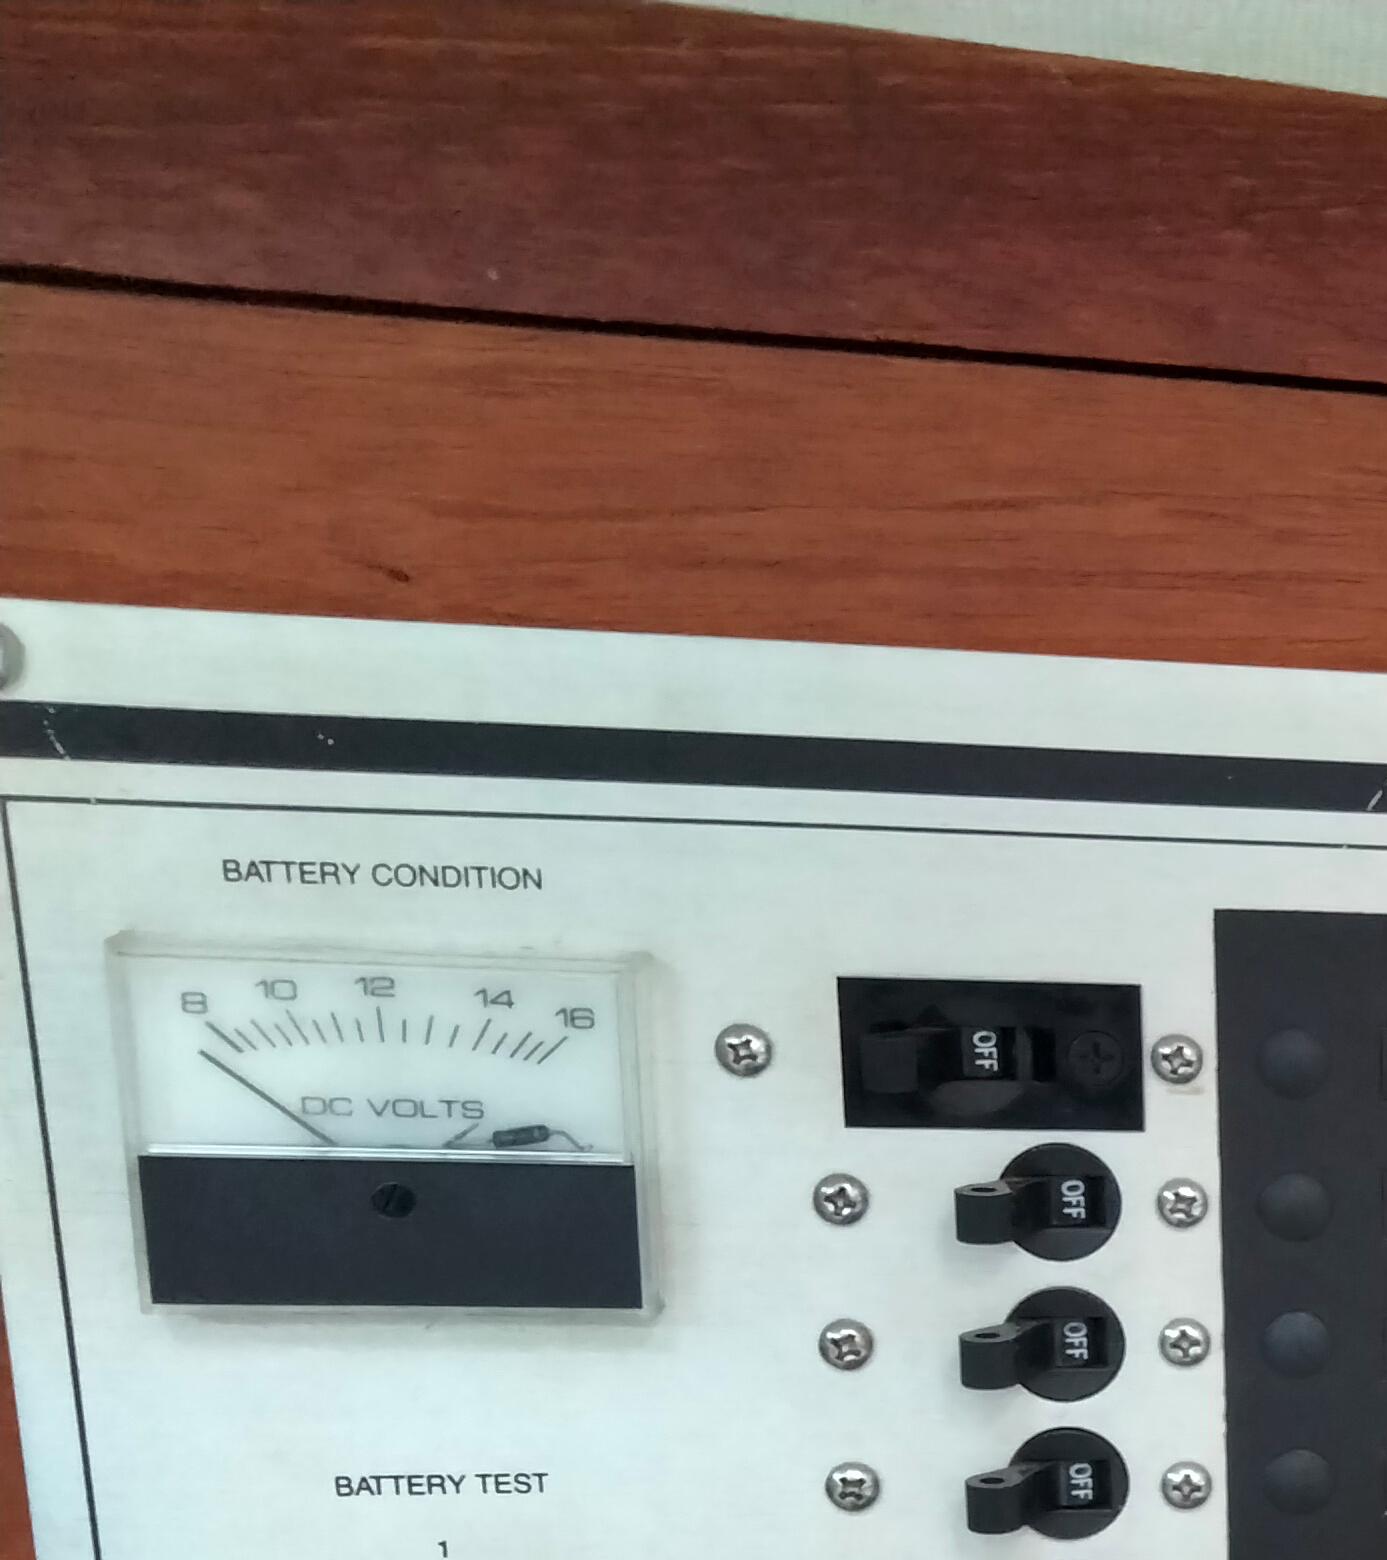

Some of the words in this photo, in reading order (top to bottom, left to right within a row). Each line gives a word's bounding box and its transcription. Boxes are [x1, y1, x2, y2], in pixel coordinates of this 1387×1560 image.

[222, 858, 361, 887] BATTERY
[371, 862, 544, 891] CONDITION
[255, 978, 298, 1001] 10
[354, 976, 396, 998] 12
[473, 987, 515, 1010] 14
[180, 991, 209, 1014] 8
[555, 1006, 596, 1030] 16
[972, 1029, 999, 1073] OFF
[301, 1096, 353, 1117] DC
[371, 1097, 486, 1121] VOLTS
[1060, 1178, 1086, 1221] OFF
[1063, 1320, 1089, 1361] OFF
[334, 1474, 467, 1497] BATTERY
[474, 1472, 550, 1495] TEST
[1068, 1461, 1094, 1501] OFF
[437, 1540, 450, 1559] 1
